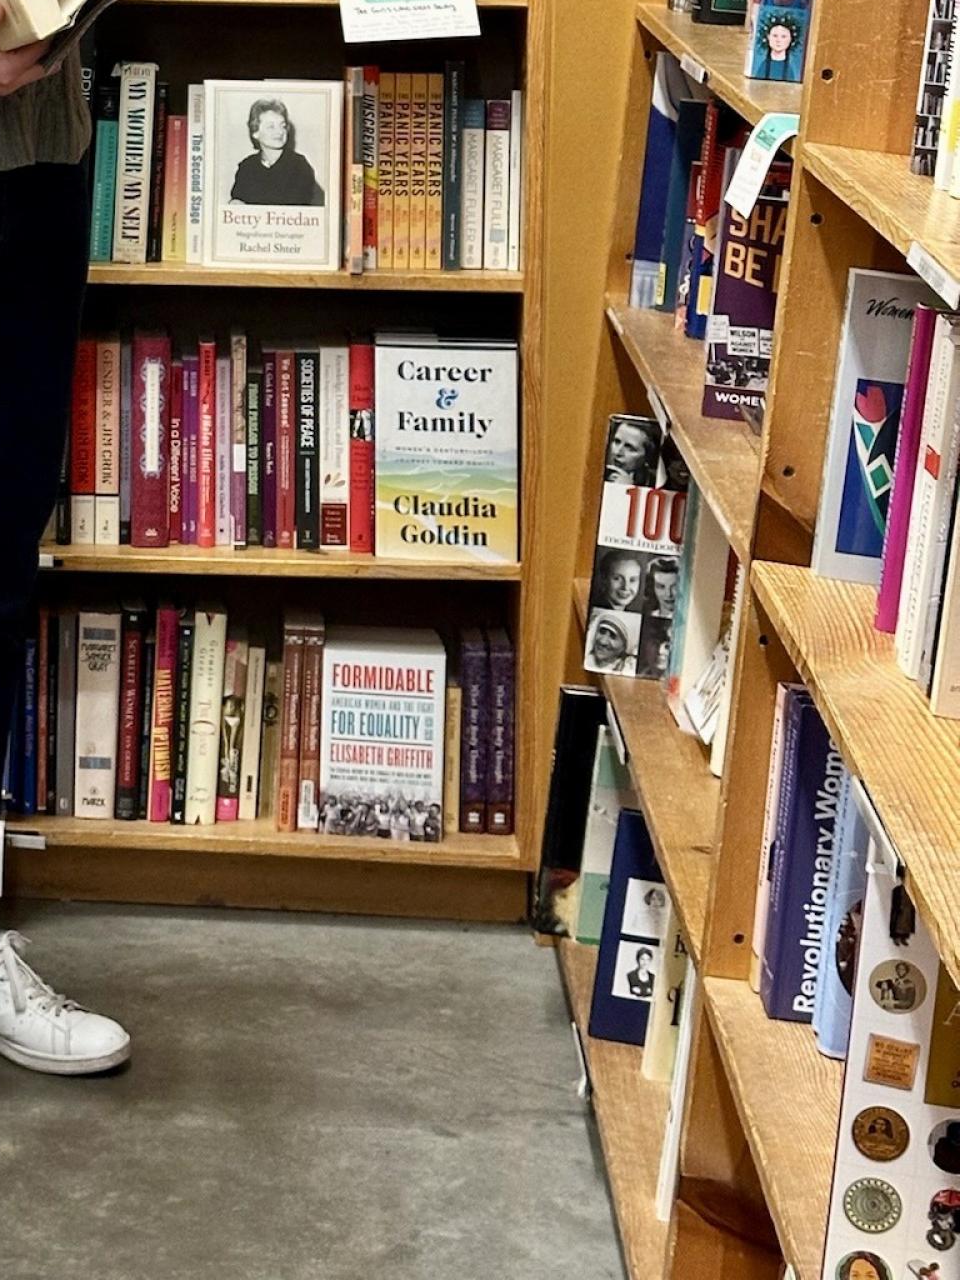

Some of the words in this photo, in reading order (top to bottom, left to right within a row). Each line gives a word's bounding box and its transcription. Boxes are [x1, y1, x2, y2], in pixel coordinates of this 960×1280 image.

[362, 94, 375, 169] UNSCREWED
[380, 102, 393, 145] PANIC
[192, 134, 202, 151] The
[192, 154, 202, 192] Second
[380, 151, 393, 197] YEARS
[468, 133, 479, 194] MARGARET
[190, 195, 202, 224] Stage
[222, 210, 264, 230] Betty
[267, 210, 320, 228] Friedan
[467, 199, 478, 241] FULLER
[239, 241, 274, 256] Rachel
[276, 241, 302, 256] Shteir
[724, 241, 764, 298] BE
[300, 358, 314, 402] SOCIETIES
[397, 360, 493, 383] Career
[300, 404, 314, 416] OF
[435, 388, 459, 410] &
[300, 418, 314, 448] PEACE
[397, 411, 493, 439] Family
[170, 440, 181, 482] Different
[170, 484, 180, 512] Voice
[393, 495, 496, 520] Claudia
[400, 525, 487, 547] Goldin
[126, 639, 137, 683] SCARLET
[332, 663, 434, 693] FORMIDABLE
[124, 689, 136, 729] WOMEN
[156, 669, 172, 725] MATERNAL
[331, 710, 355, 735] FOR
[359, 713, 420, 740] EQUALITY
[153, 726, 170, 781] OPTIMISM
[330, 743, 384, 766] ELISABETH
[387, 748, 433, 770] GRIFFITH
[793, 826, 834, 1014] Revolutionary
